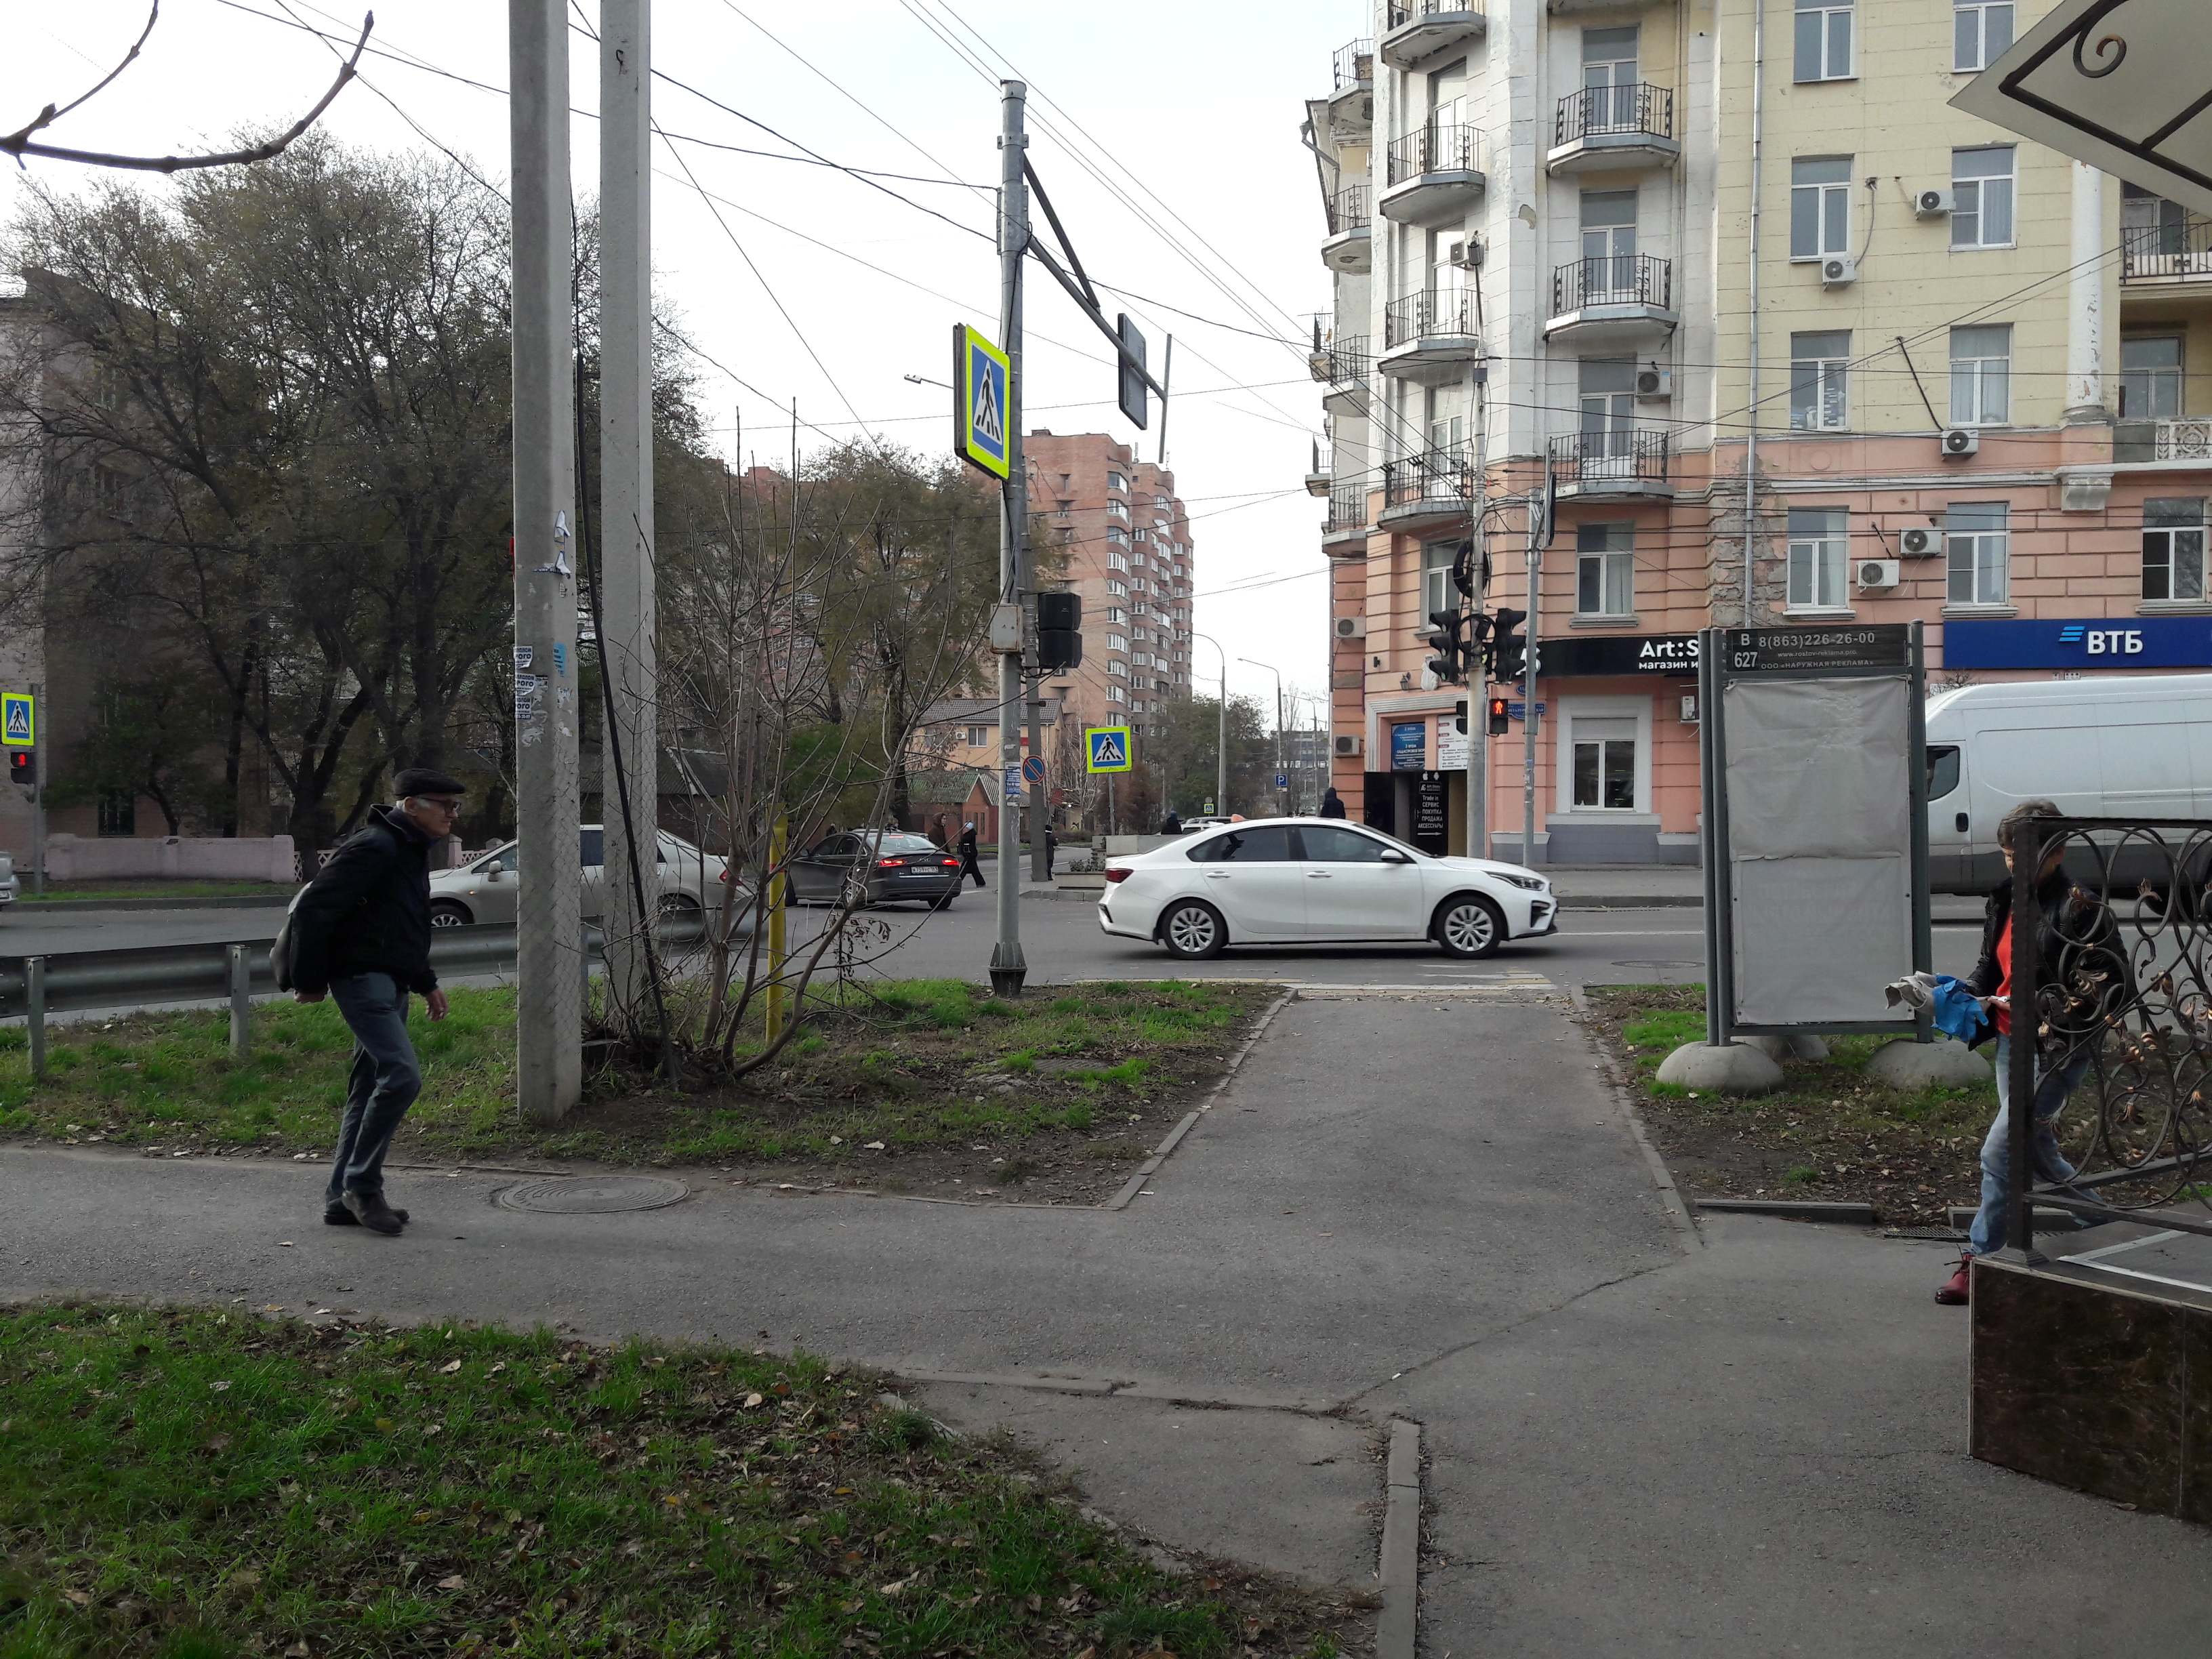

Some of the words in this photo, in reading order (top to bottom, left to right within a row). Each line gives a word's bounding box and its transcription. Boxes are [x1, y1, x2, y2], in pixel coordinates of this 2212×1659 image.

[1759, 632, 1875, 649] 8(863)226-26-00
[2087, 630, 2144, 655] ВТБ
[1639, 661, 1687, 670] магазин
[1734, 651, 1758, 668] 627
[1781, 661, 1830, 669] «НАРУЖНАЯ
